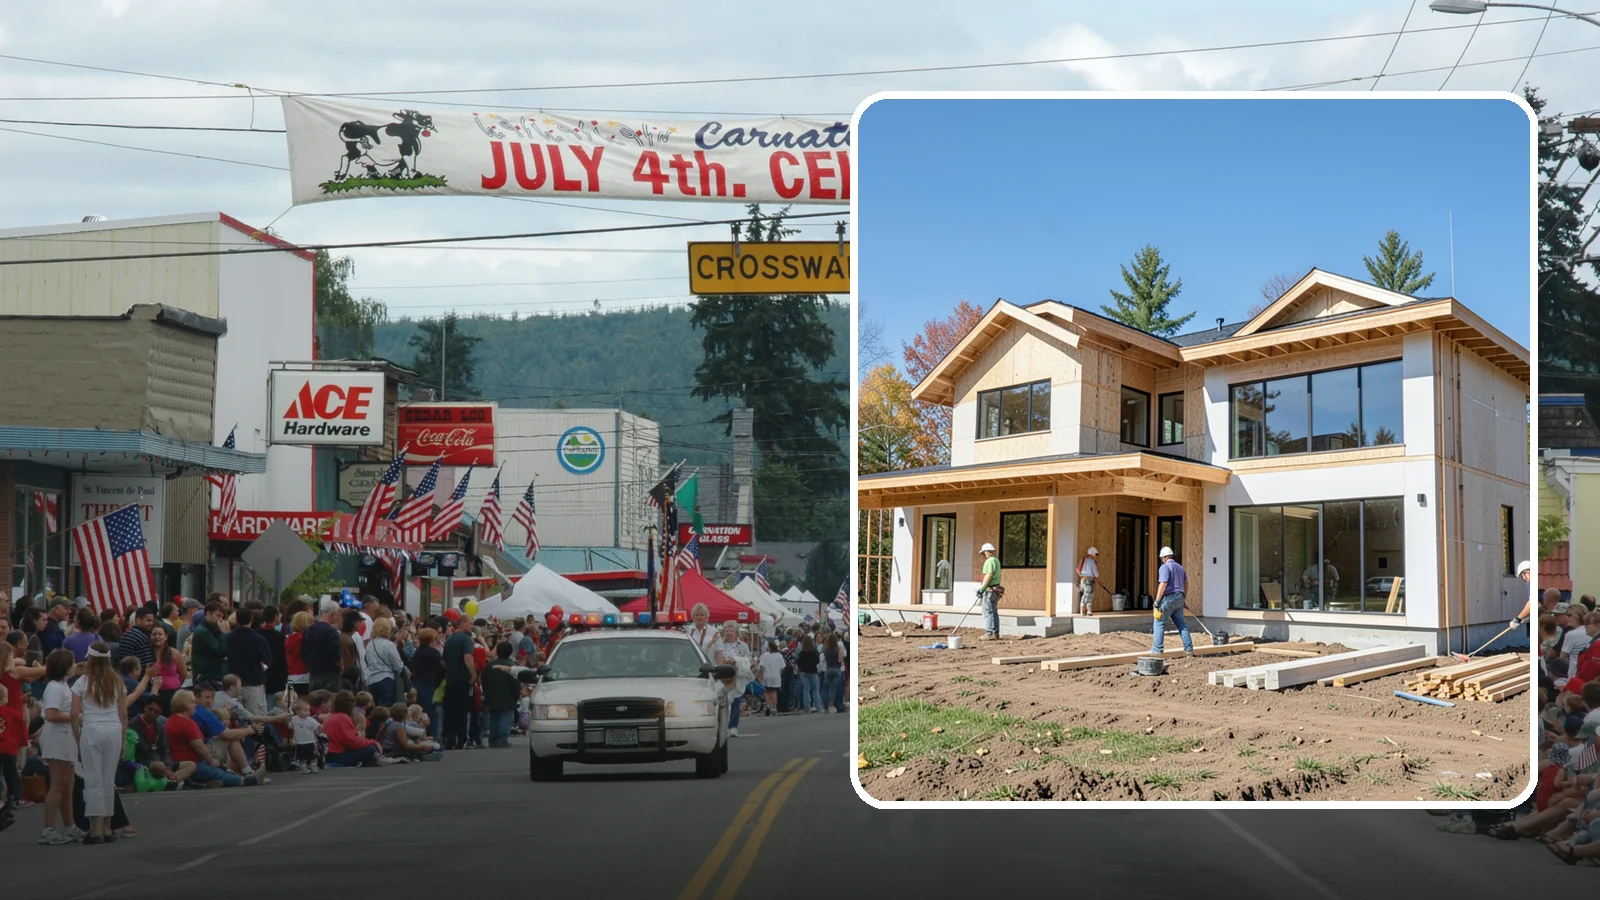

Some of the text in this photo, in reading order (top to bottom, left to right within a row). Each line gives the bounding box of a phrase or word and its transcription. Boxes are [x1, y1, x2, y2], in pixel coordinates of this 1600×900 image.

[695, 121, 850, 150] Carnat
[481, 141, 605, 192] JULY
[632, 150, 746, 198] 4th.
[697, 254, 850, 280] CROSSWA
[282, 380, 373, 420] ACE
[405, 409, 485, 422] CEDAR LOG
[283, 421, 371, 436] Hardware
[416, 428, 477, 447] Coca-Cola
[353, 467, 385, 480] Simpl
[83, 485, 155, 495] St. Vincent de Paul
[688, 526, 742, 535] CRNATION
[699, 535, 730, 543] GLASS
